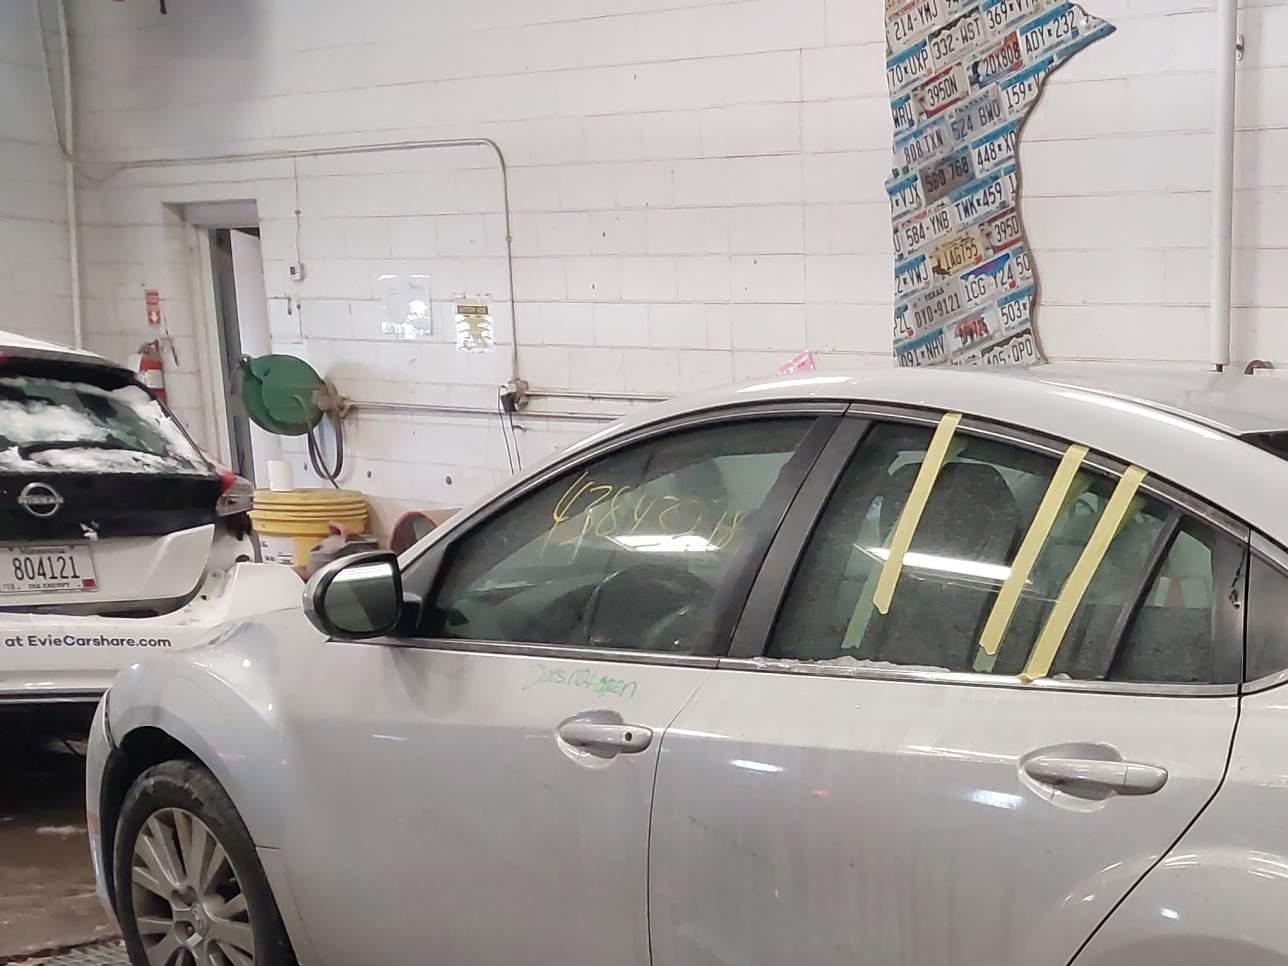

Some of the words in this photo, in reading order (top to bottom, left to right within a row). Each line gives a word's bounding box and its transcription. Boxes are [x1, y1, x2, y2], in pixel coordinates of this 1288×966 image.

[12, 555, 80, 581] 804121
[4, 637, 23, 648] at
[28, 635, 172, 648] EvieCarshare.com
